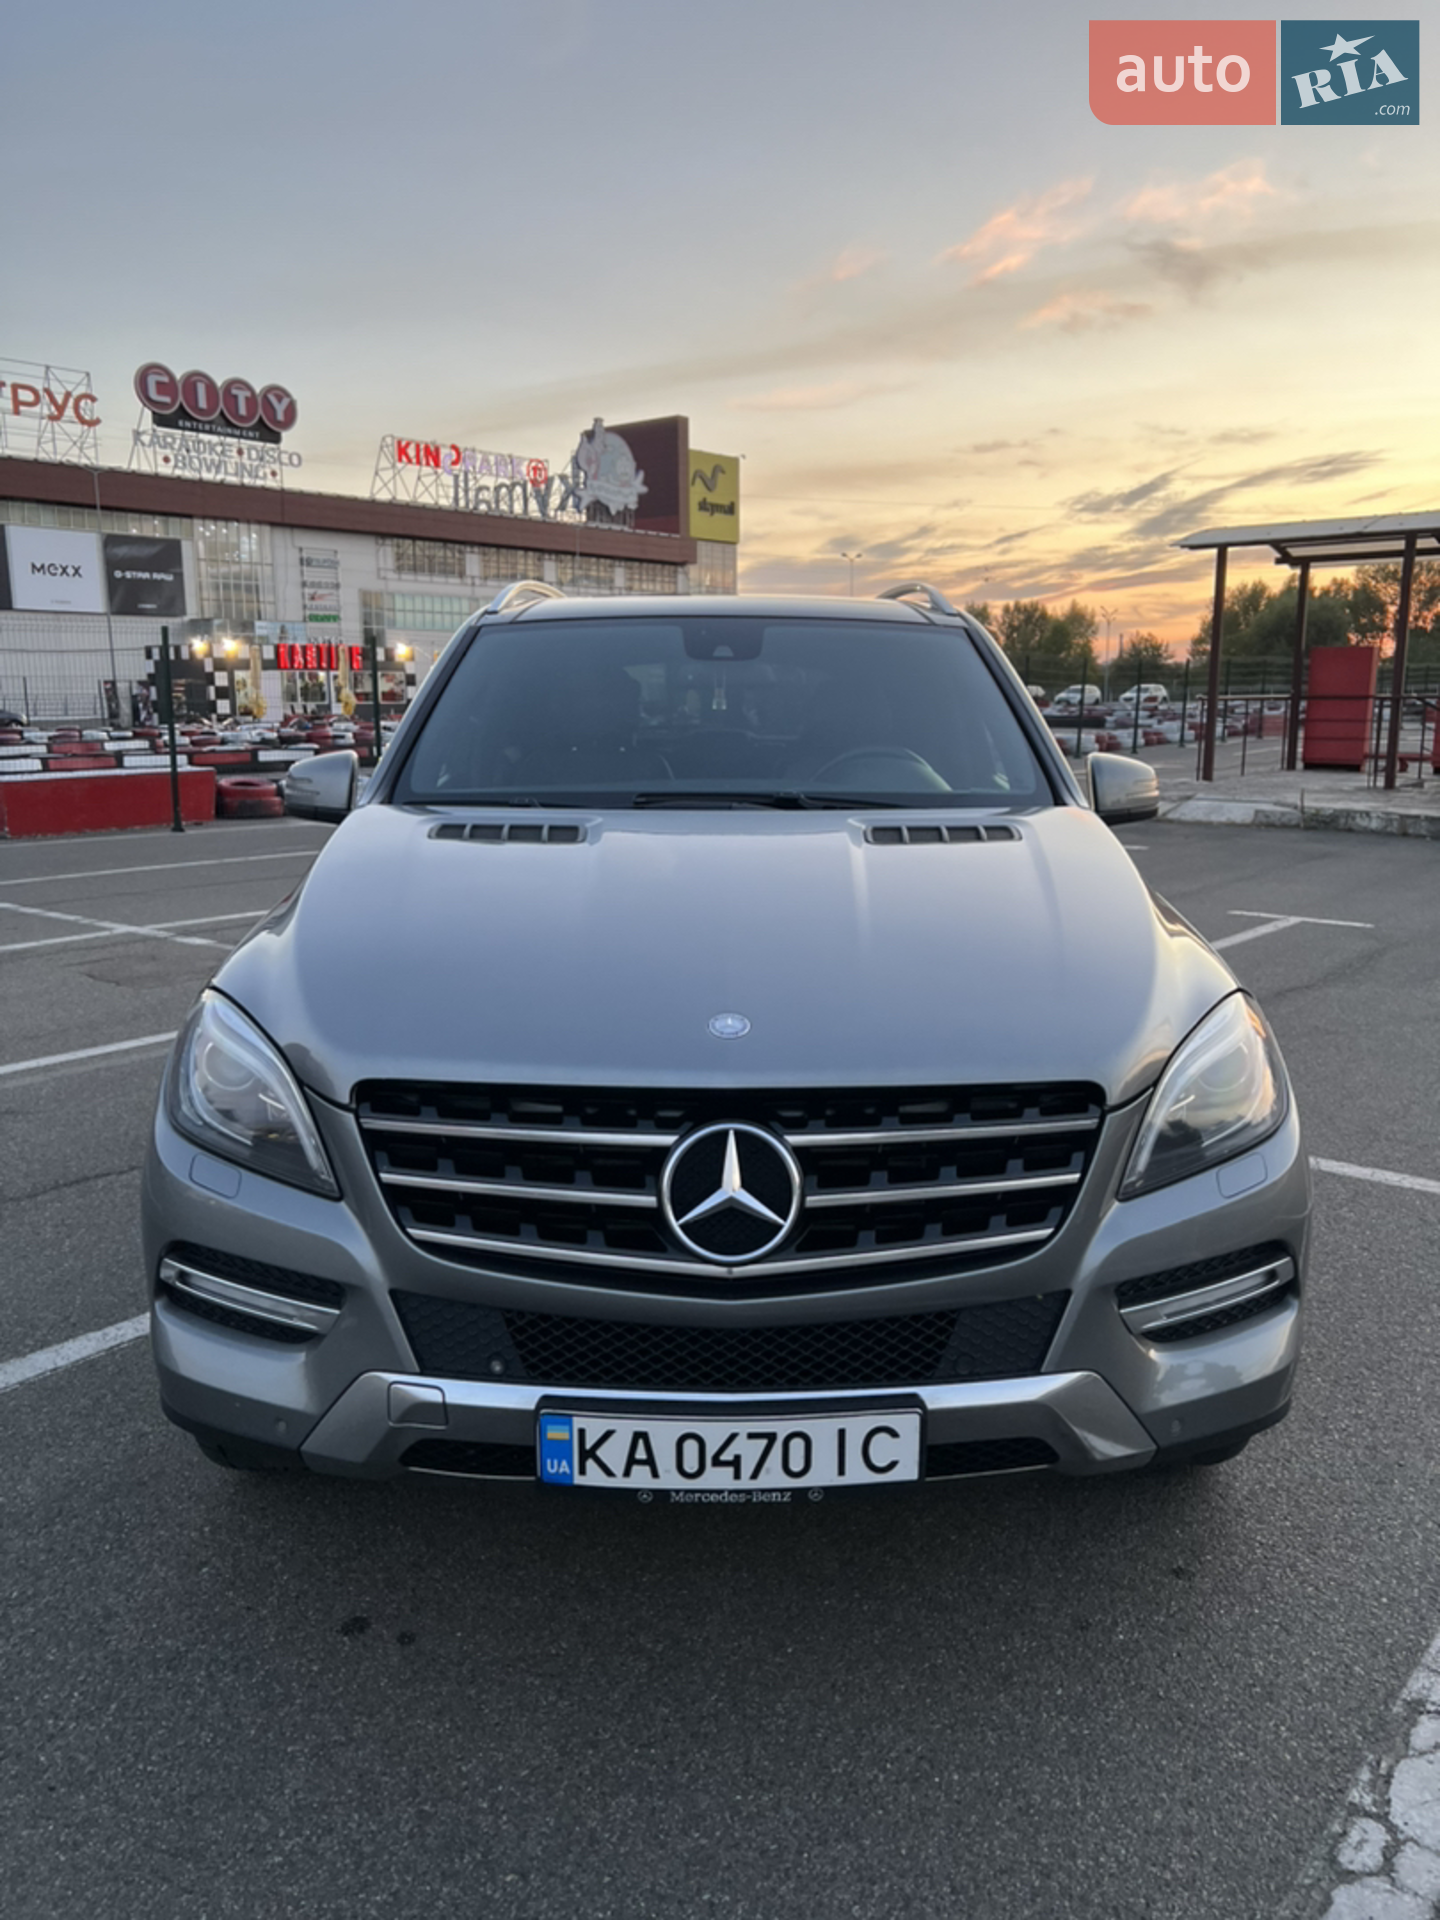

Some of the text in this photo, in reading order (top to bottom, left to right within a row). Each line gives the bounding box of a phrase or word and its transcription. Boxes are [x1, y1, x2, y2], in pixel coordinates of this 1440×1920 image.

[146, 372, 291, 422] CITY
[177, 418, 261, 440] ENTERTAINMENT
[132, 428, 303, 469] KARAOKE DISCO
[173, 452, 268, 481] BOWLING
[546, 1459, 570, 1475] UA
[577, 1428, 660, 1479] KA
[675, 1431, 812, 1480] 0470
[670, 1490, 792, 1503] Mercedes-Benz
